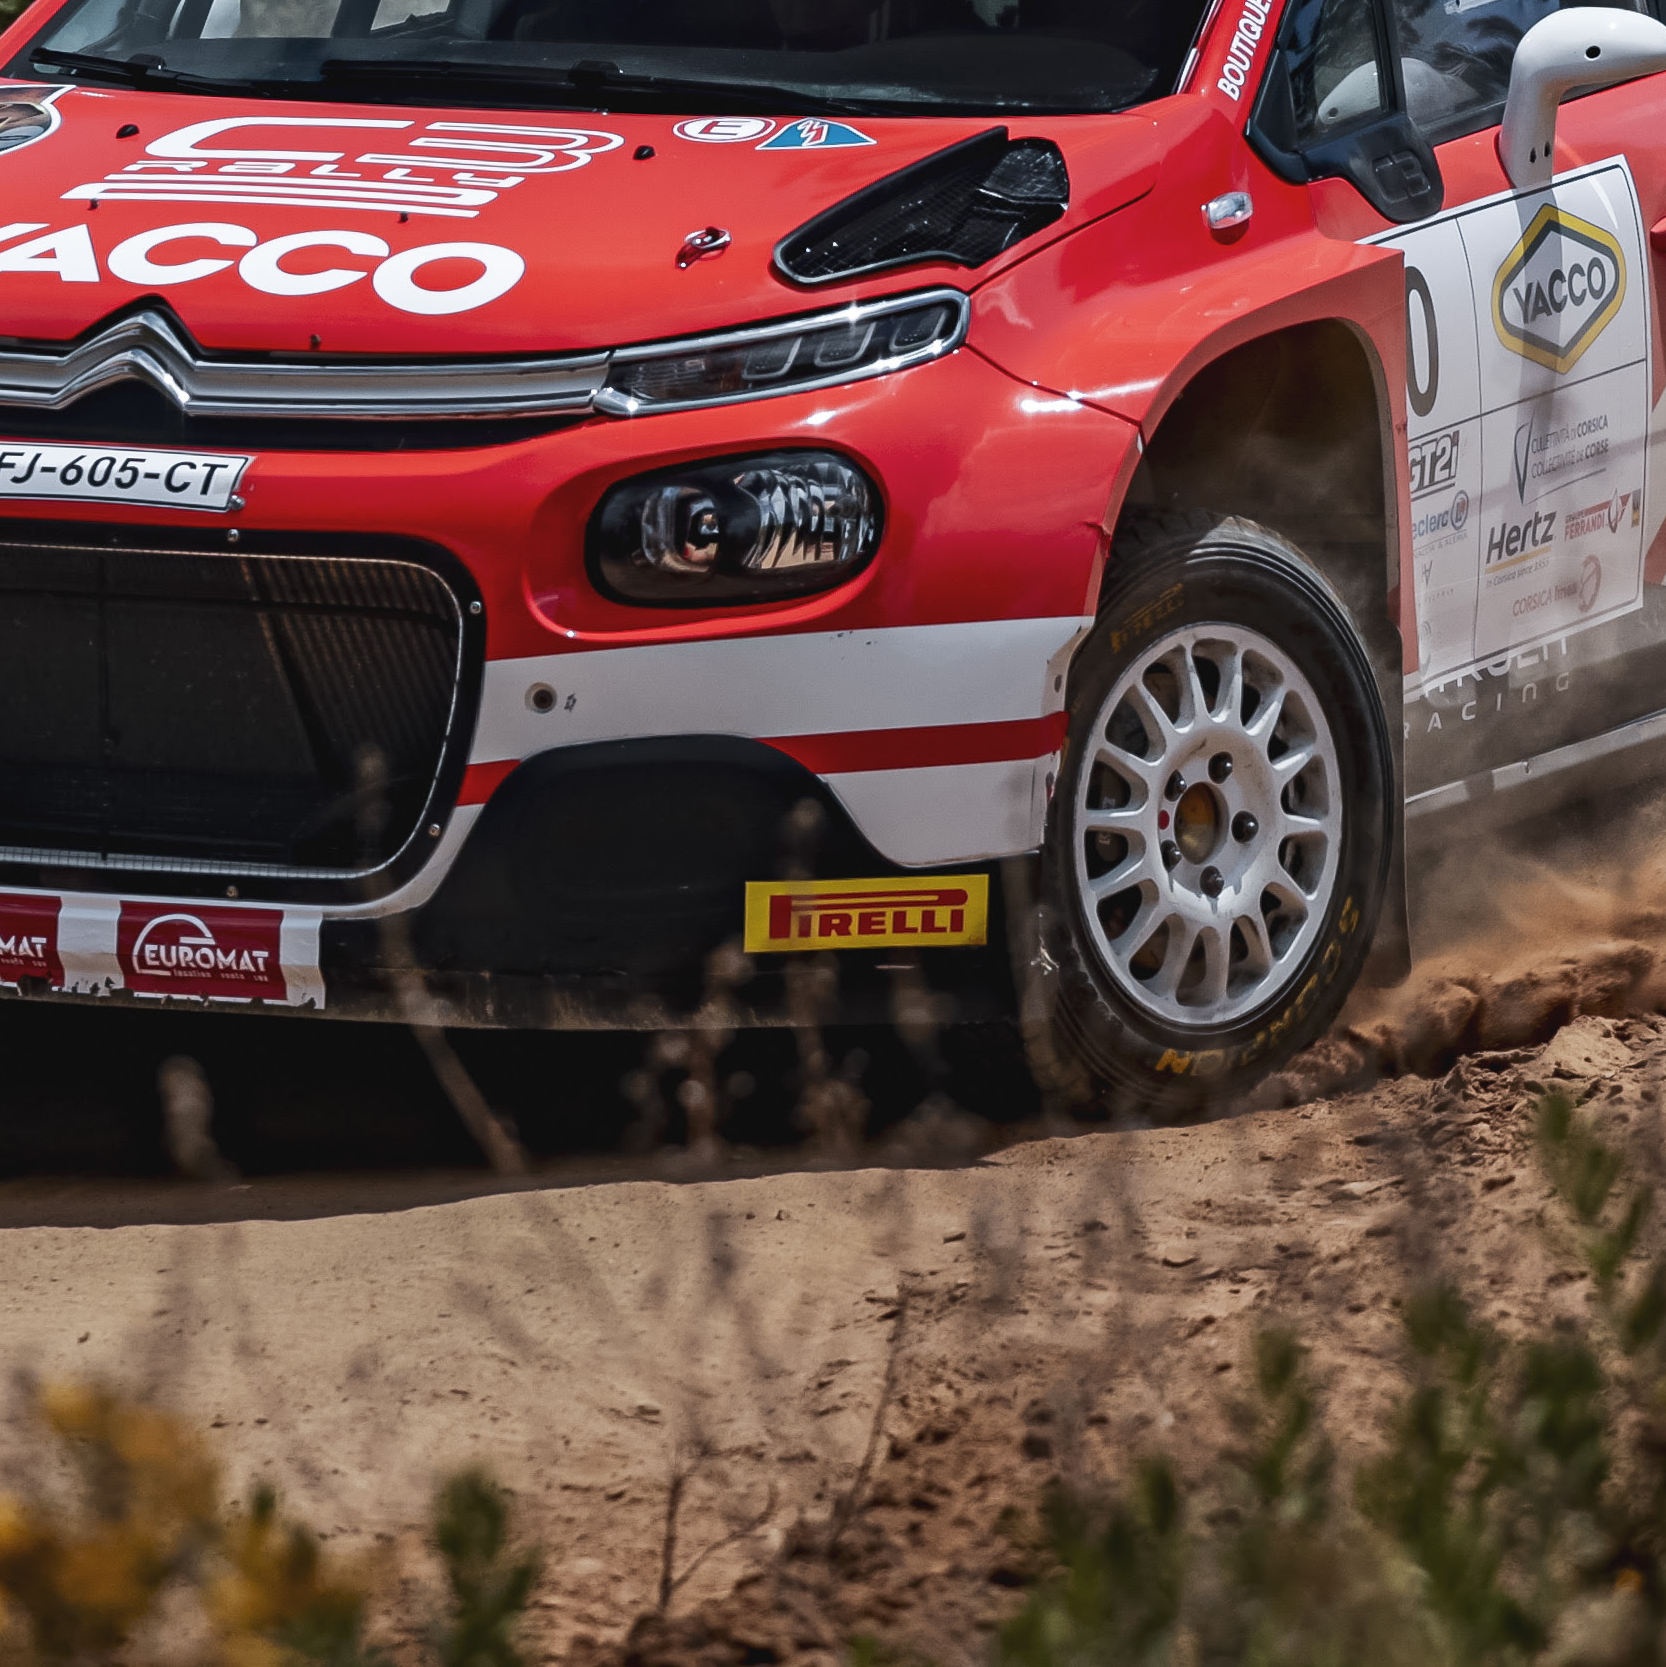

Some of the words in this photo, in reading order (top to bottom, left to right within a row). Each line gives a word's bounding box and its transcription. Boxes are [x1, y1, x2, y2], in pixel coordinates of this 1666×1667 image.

[122, 159, 526, 189] RALLY
[1513, 257, 1606, 324] YACCO
[1405, 266, 1439, 417] 0
[1577, 414, 1609, 438] CORSICA
[1485, 510, 1557, 565] Hertz
[1564, 512, 1606, 542] FERRANDI
[1512, 589, 1552, 618] CORSICA
[769, 888, 969, 940] PIRELLI
[144, 943, 270, 972] EUROMAT
